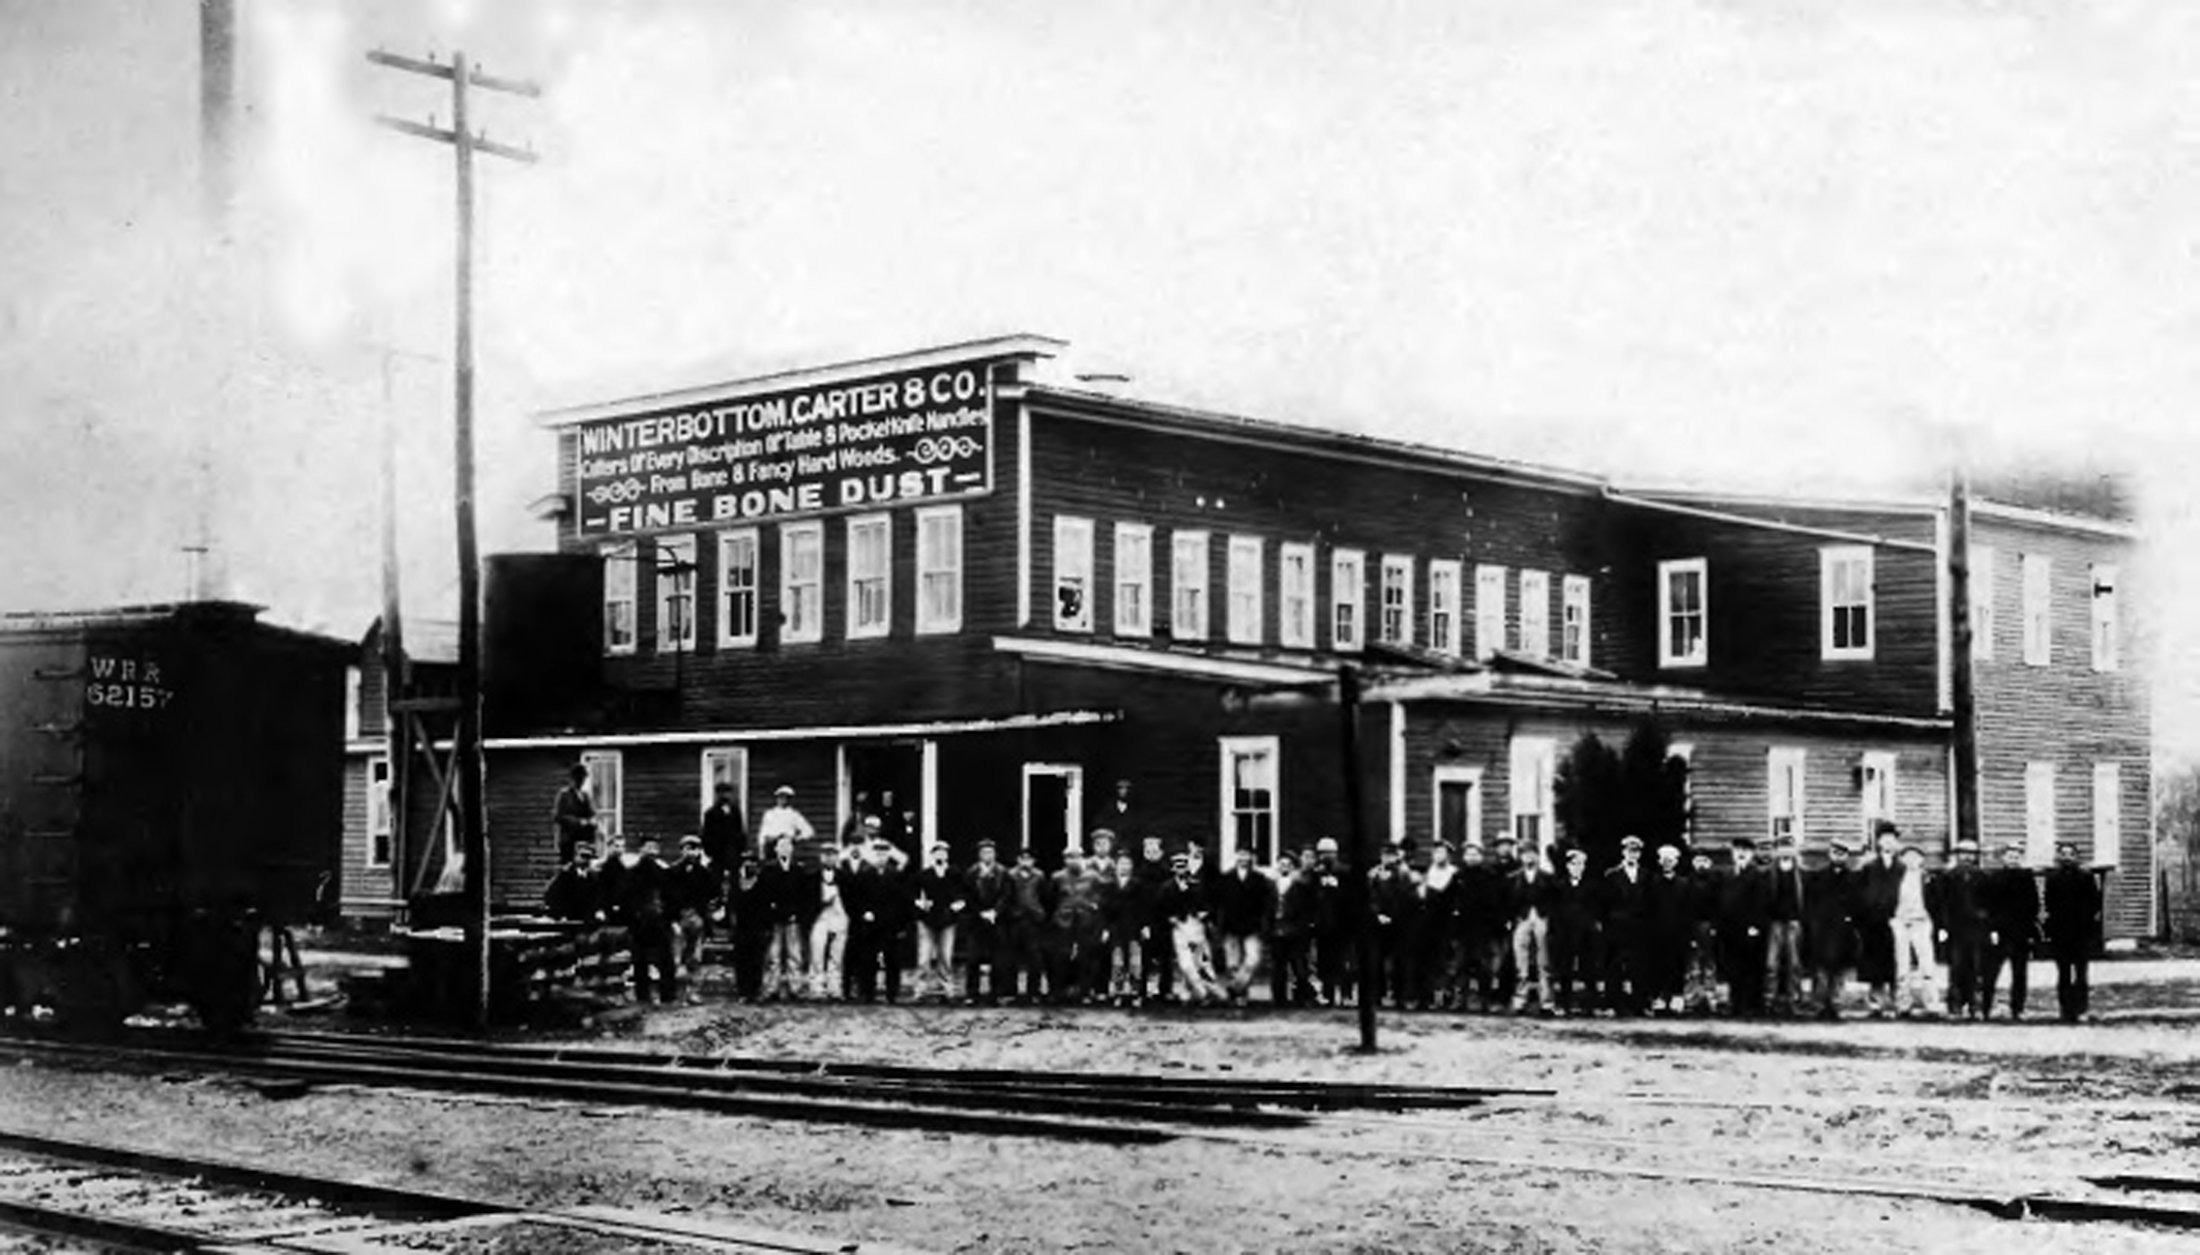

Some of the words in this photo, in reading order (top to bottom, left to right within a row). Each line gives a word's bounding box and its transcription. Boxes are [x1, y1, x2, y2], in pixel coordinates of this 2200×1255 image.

[791, 383, 898, 423] CARTER
[930, 369, 987, 403] CO.
[650, 474, 687, 493] From
[798, 451, 836, 475] Hard
[713, 483, 822, 519] BONE
